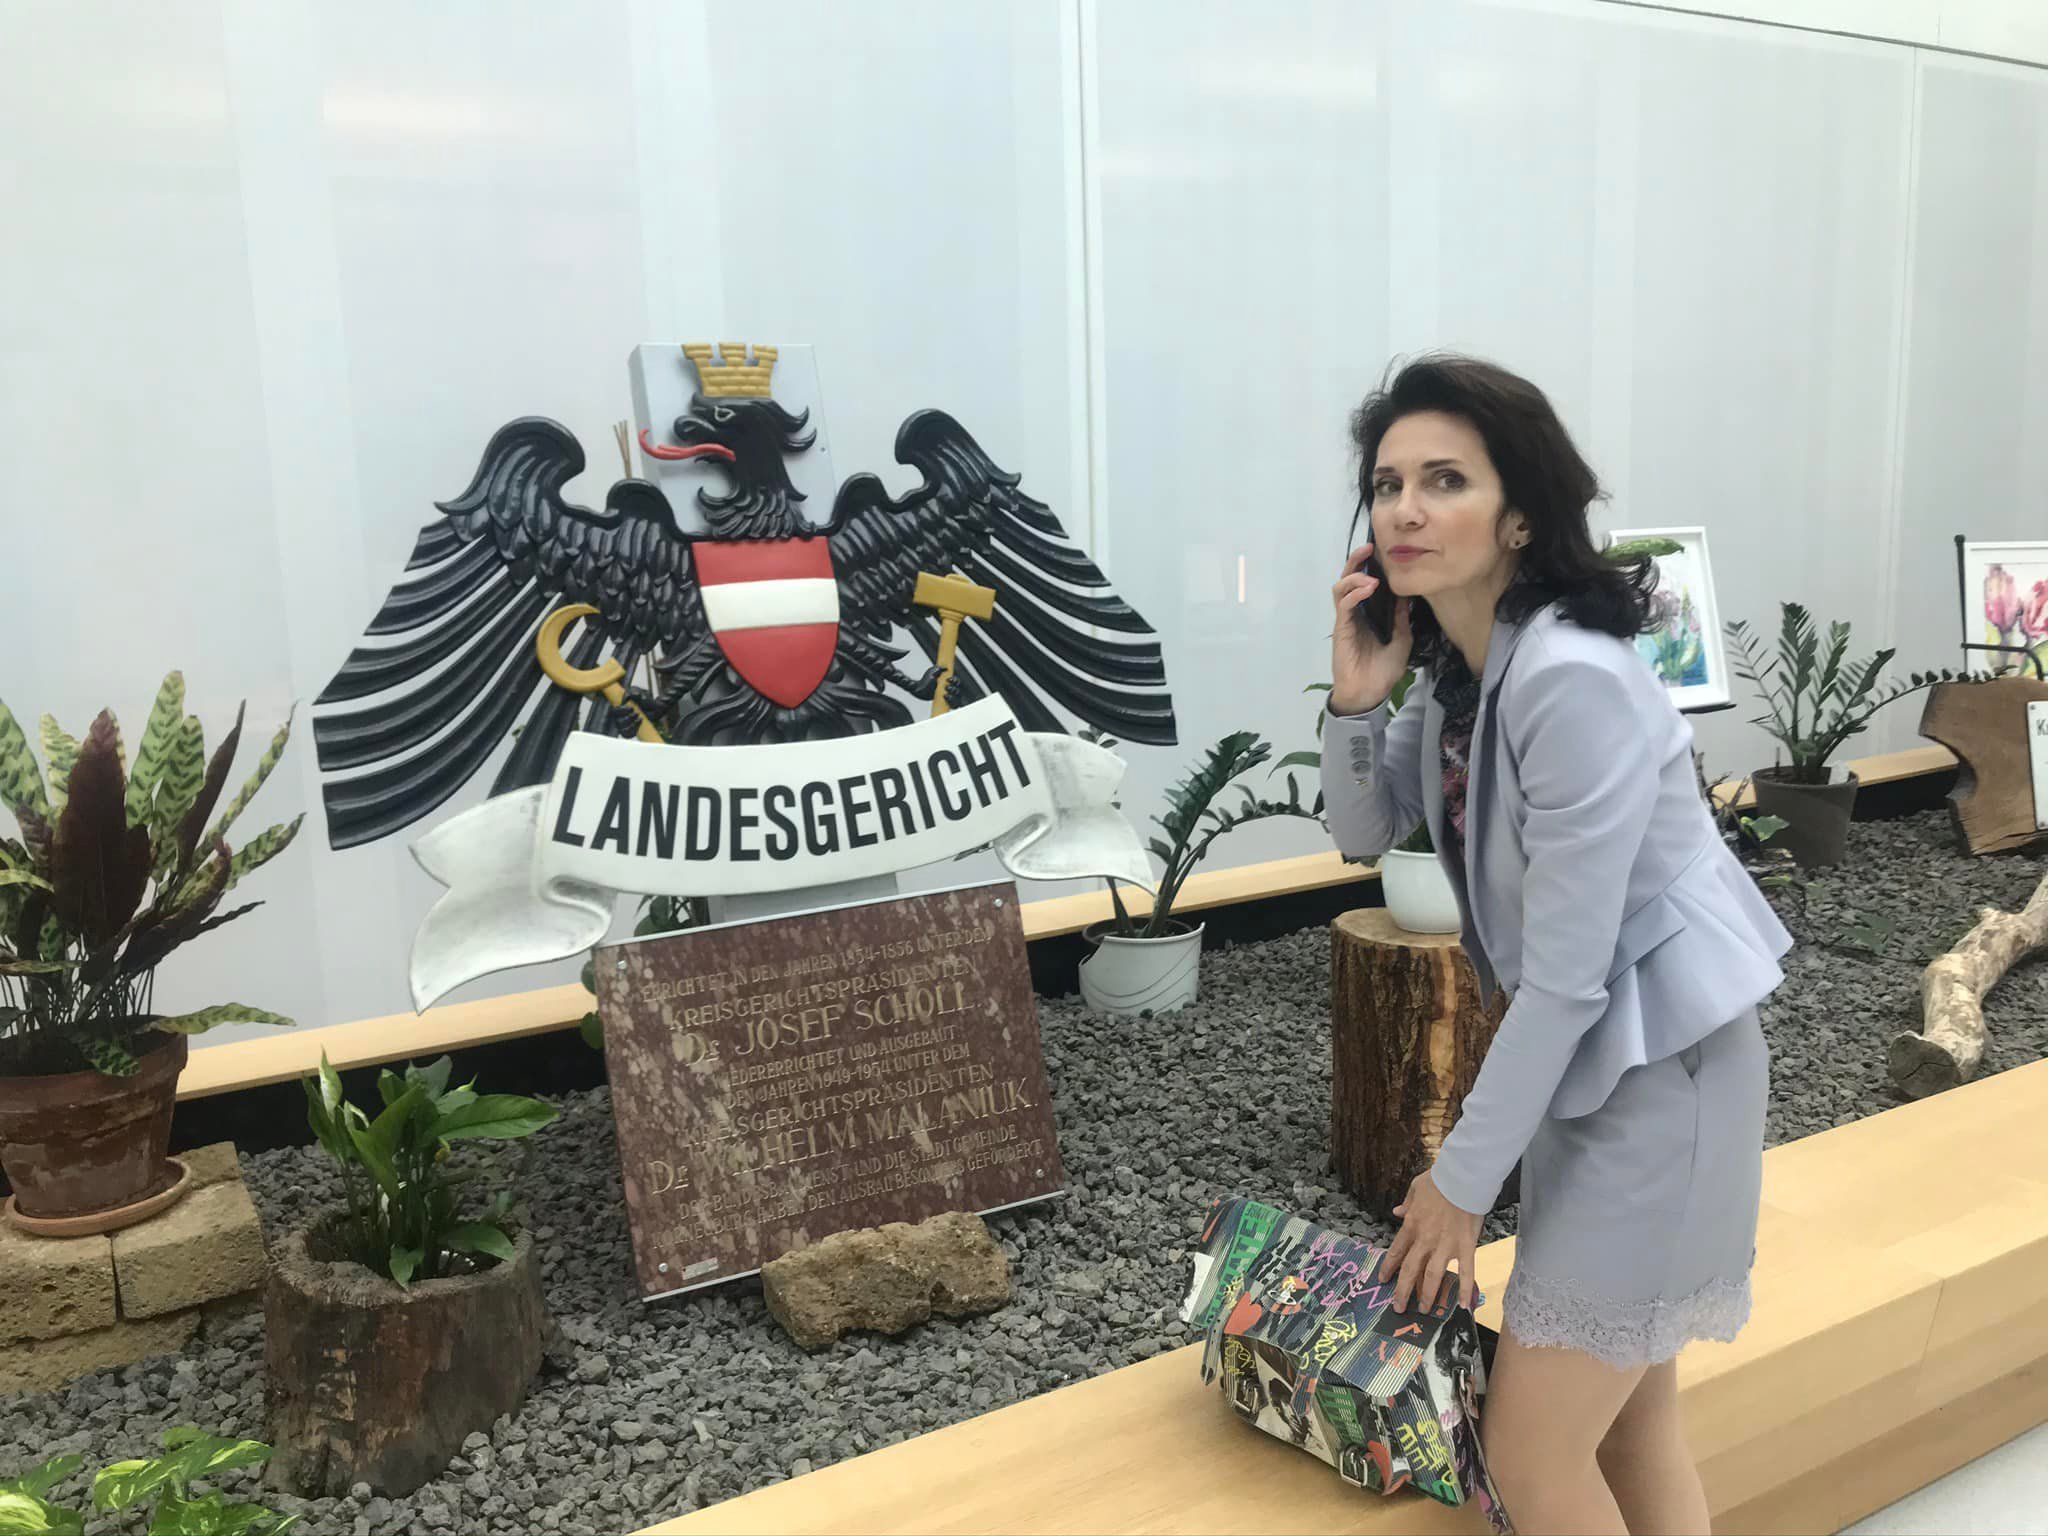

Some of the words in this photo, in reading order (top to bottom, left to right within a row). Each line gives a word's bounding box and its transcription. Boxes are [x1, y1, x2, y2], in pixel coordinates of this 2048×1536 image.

[552, 720, 1032, 862] LANDESGERICHT
[750, 963, 778, 982] DEN
[782, 953, 837, 977] JAHREN
[731, 1003, 843, 1055] JOSEF
[848, 1040, 875, 1061] UND
[756, 1074, 813, 1102] JAHREN
[815, 1058, 891, 1089] 1949-1954
[893, 1048, 940, 1072] UNTER
[941, 1041, 970, 1062] DEM
